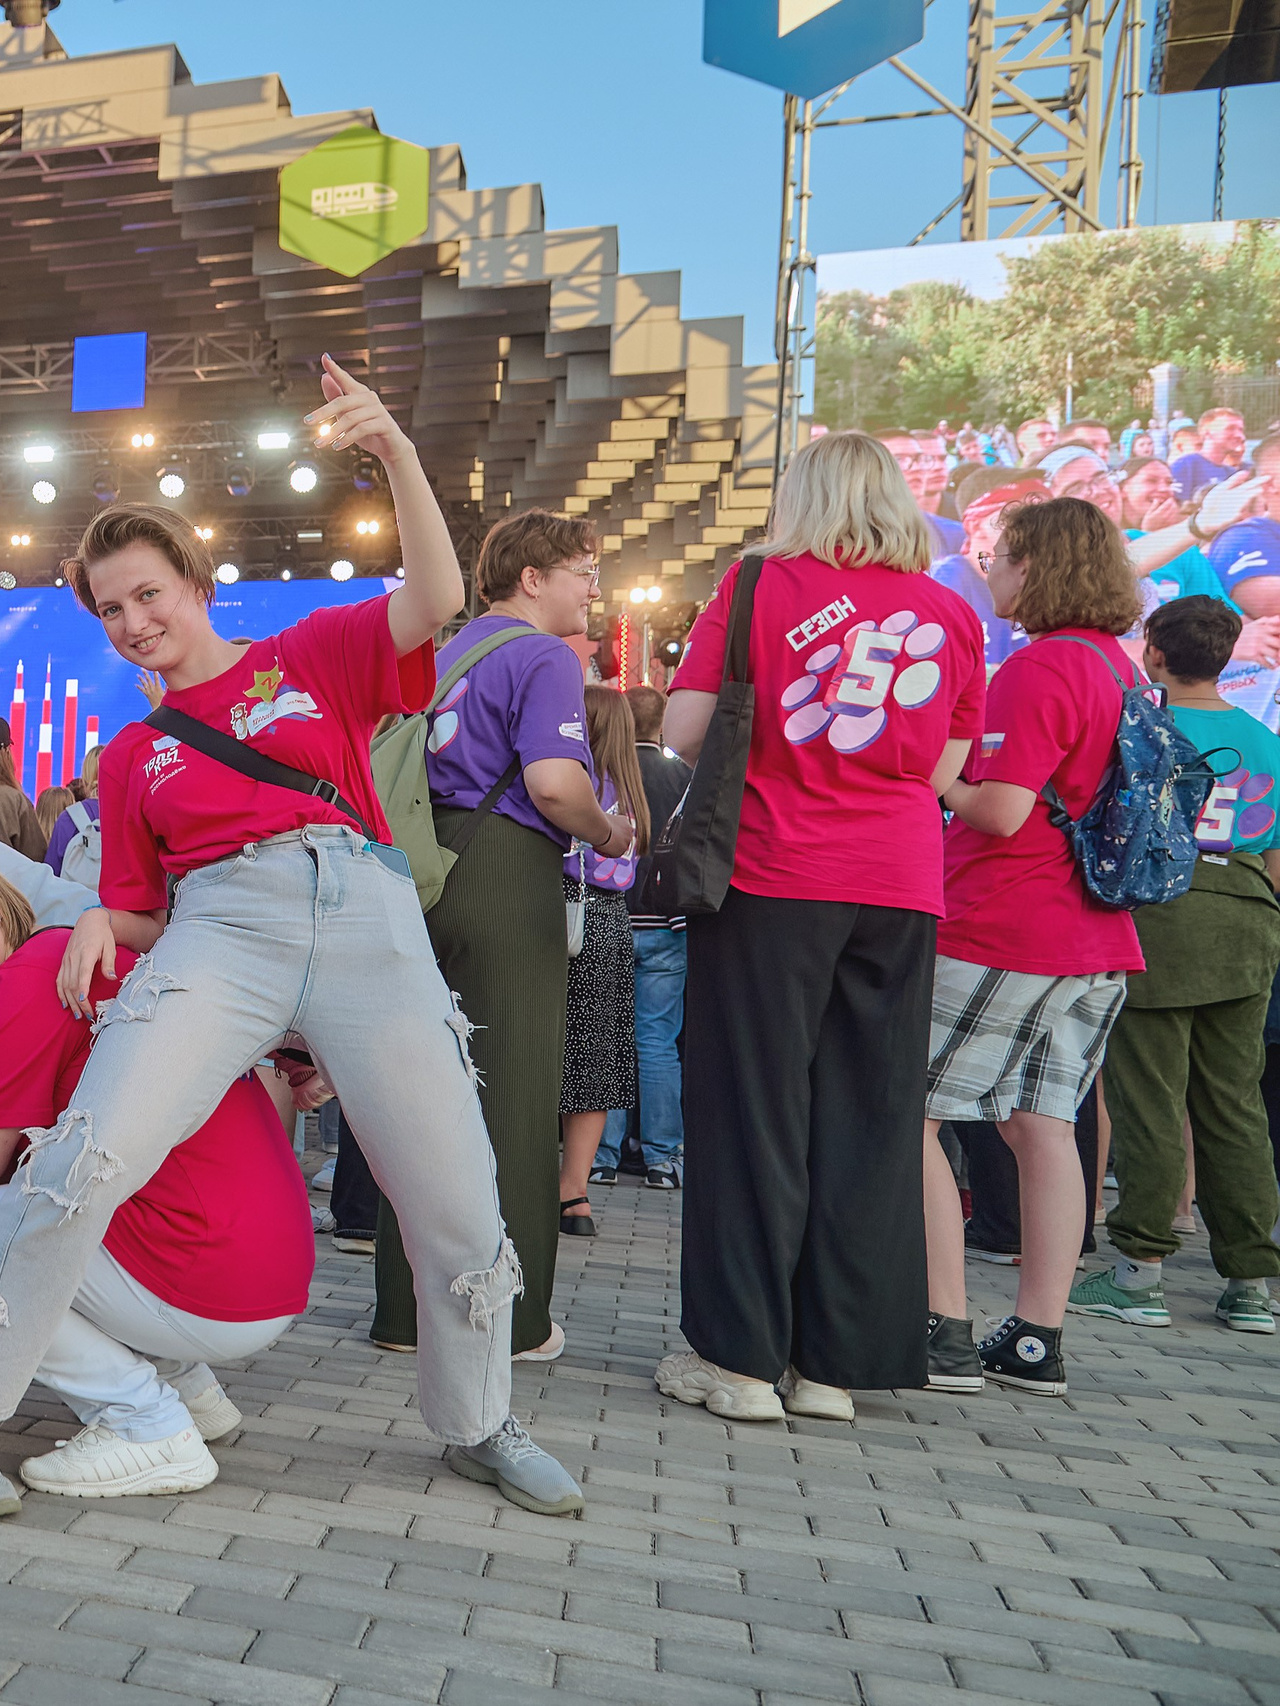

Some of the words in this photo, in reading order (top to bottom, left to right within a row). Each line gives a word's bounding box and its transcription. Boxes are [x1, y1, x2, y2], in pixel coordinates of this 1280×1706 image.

[785, 595, 857, 652] СЕЗОН
[836, 629, 904, 707] 5
[1217, 676, 1257, 694] ЕРВЫХ
[1194, 786, 1238, 841] 5
